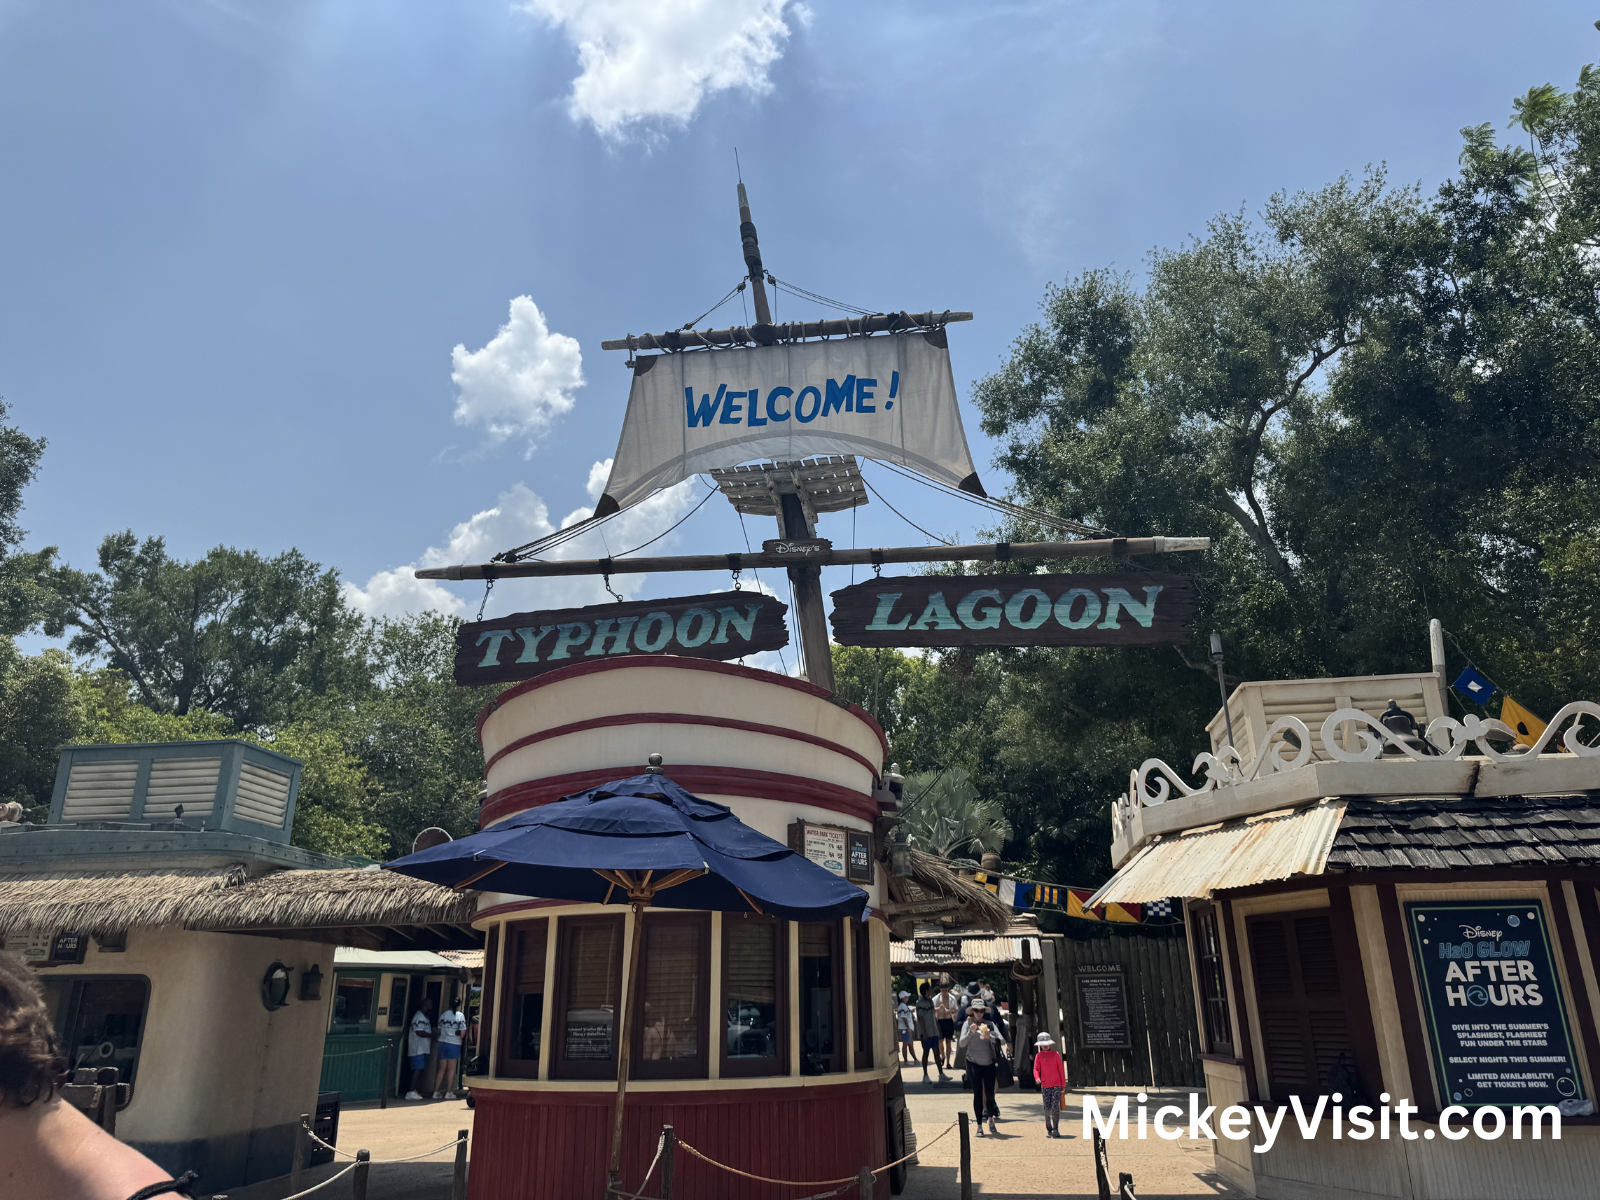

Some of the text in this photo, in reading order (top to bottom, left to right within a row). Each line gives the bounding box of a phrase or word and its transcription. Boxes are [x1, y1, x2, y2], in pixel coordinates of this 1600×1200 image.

[684, 371, 899, 428] WELCOME!
[774, 542, 820, 556] Disney's
[865, 585, 1163, 630] LAGOON
[475, 604, 764, 668] TYPHOON
[1459, 925, 1503, 941] Disney
[1439, 940, 1531, 959] H2O GLOW
[1445, 960, 1538, 982] AFTER
[1445, 984, 1544, 1007] HOURS
